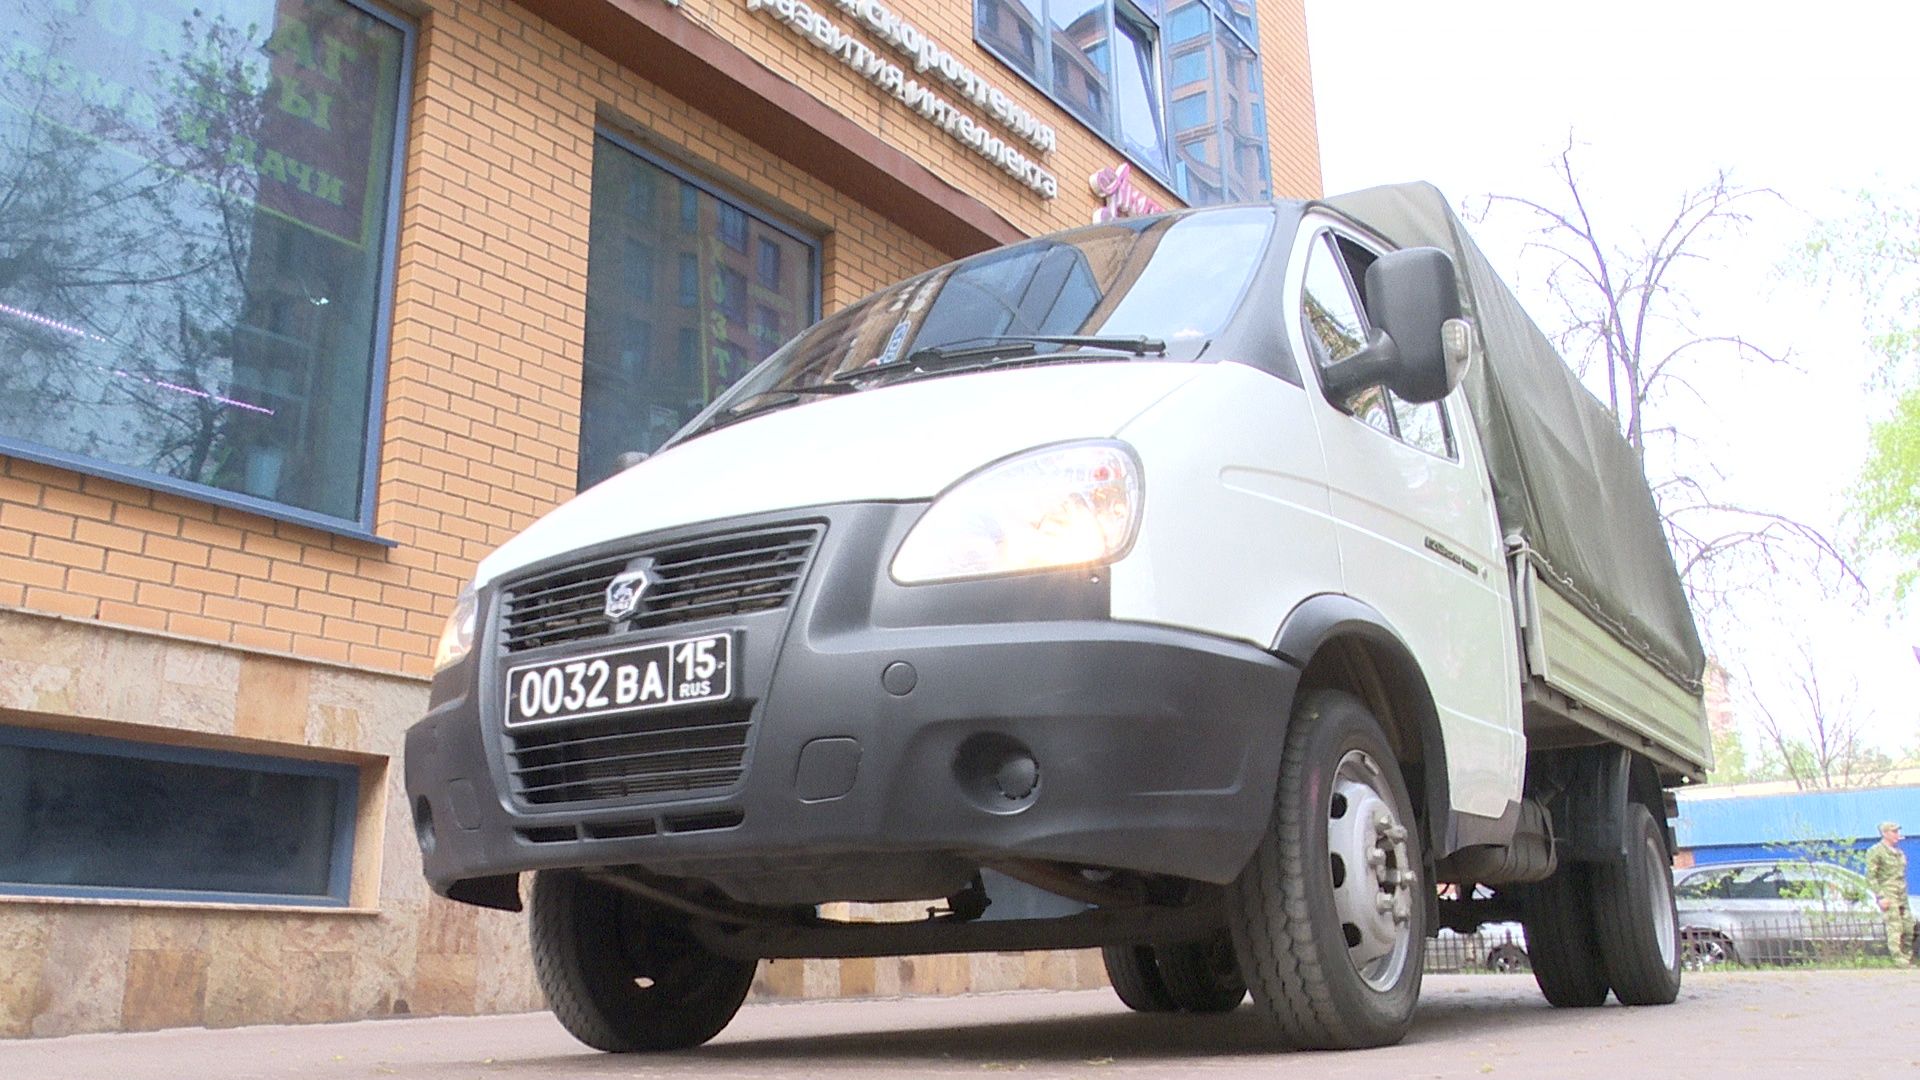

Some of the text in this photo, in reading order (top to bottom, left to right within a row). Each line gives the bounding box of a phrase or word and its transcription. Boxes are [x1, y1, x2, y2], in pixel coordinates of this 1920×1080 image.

[902, 79, 1058, 199] интеллекта
[519, 660, 610, 718] 0032
[676, 640, 716, 681] 15
[679, 680, 712, 698] RUS
